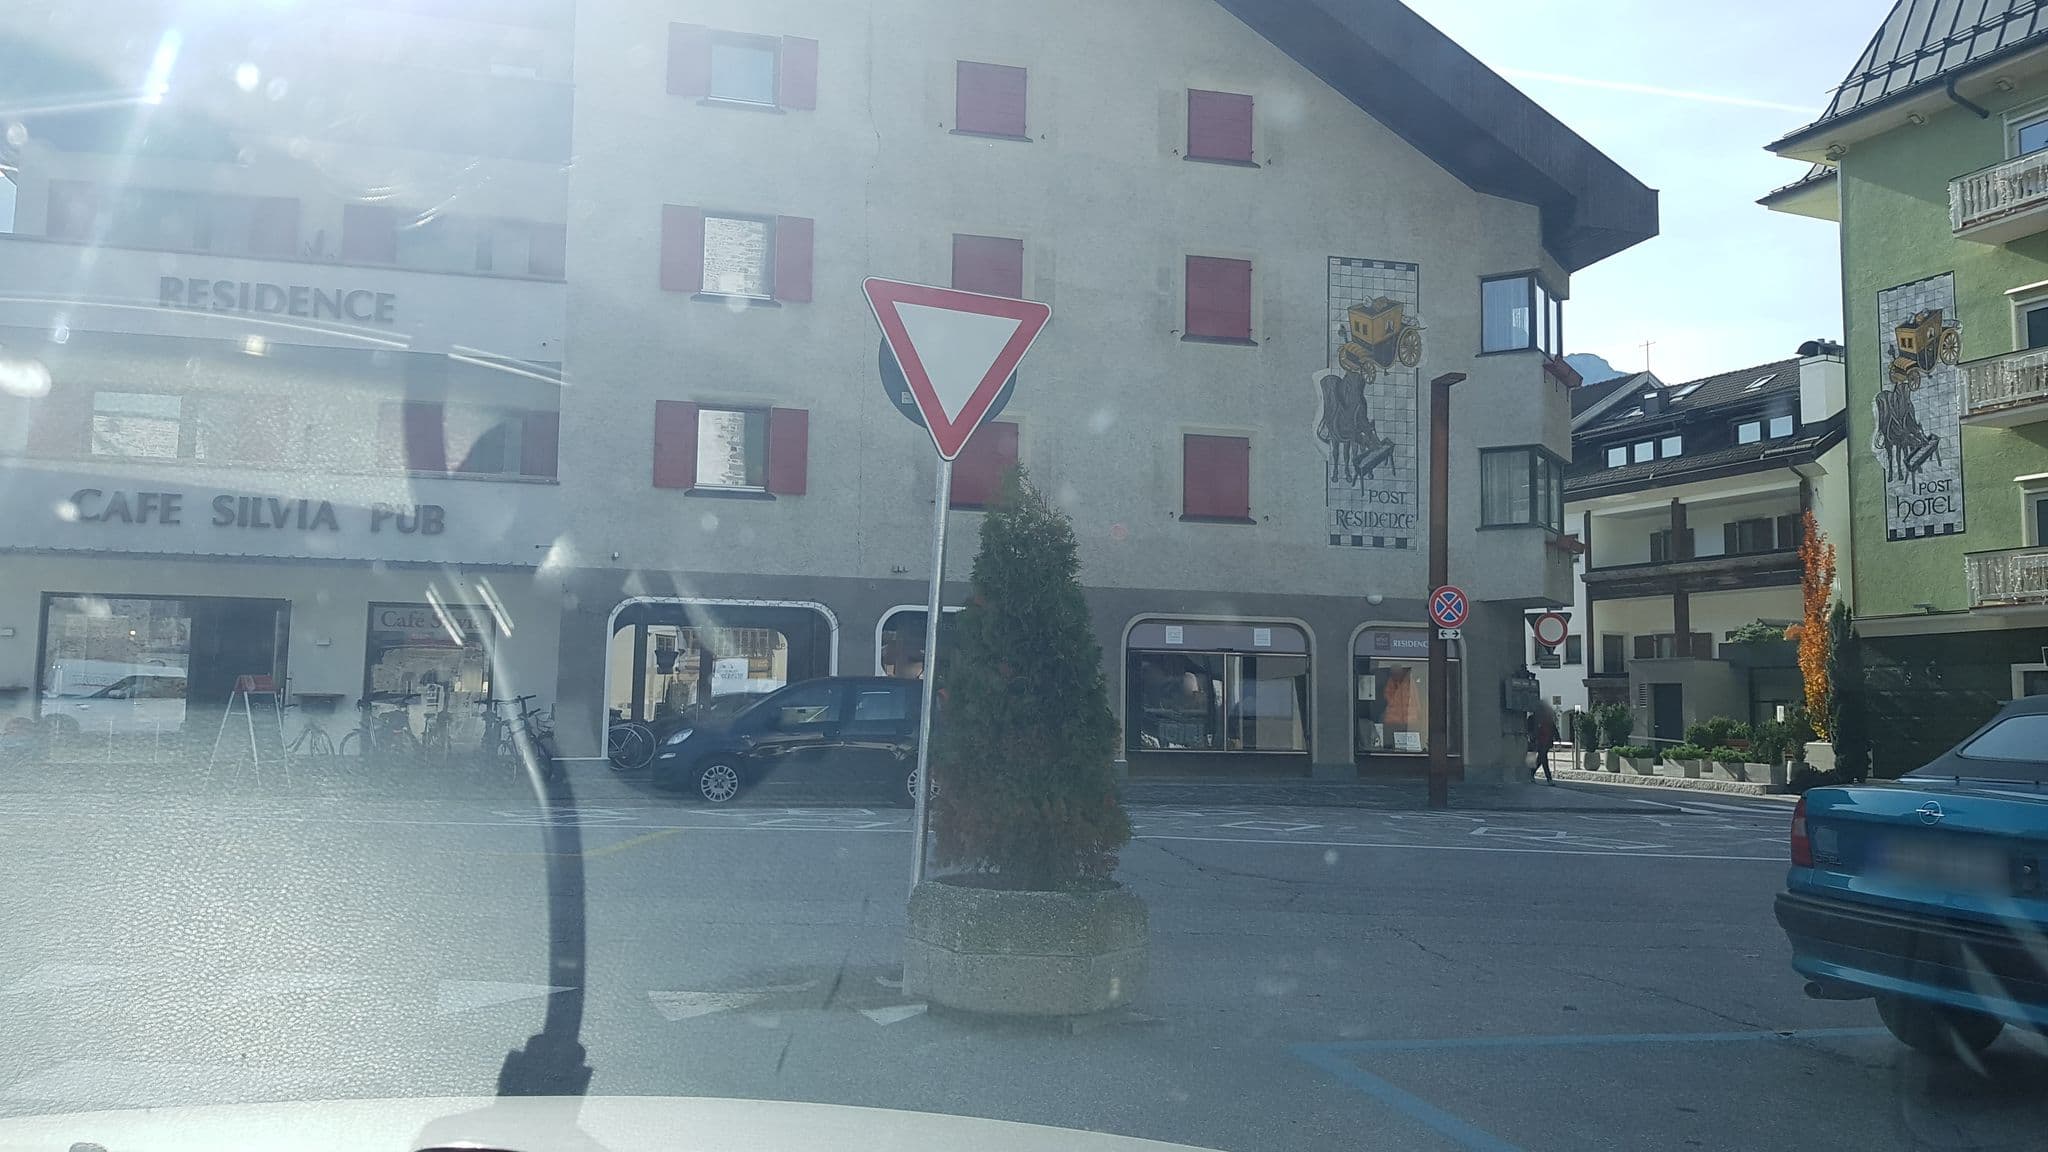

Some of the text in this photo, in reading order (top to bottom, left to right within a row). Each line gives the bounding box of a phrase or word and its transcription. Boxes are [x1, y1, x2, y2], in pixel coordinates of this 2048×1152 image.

[159, 276, 396, 322] RESIDENCE
[1919, 478, 1953, 496] POST
[1368, 489, 1408, 505] POST
[70, 488, 445, 536] CAFE SILVIA PUB
[1336, 509, 1416, 530] RESIDENCE
[381, 610, 425, 628] Café
[1392, 639, 1430, 649] RESIDENC
